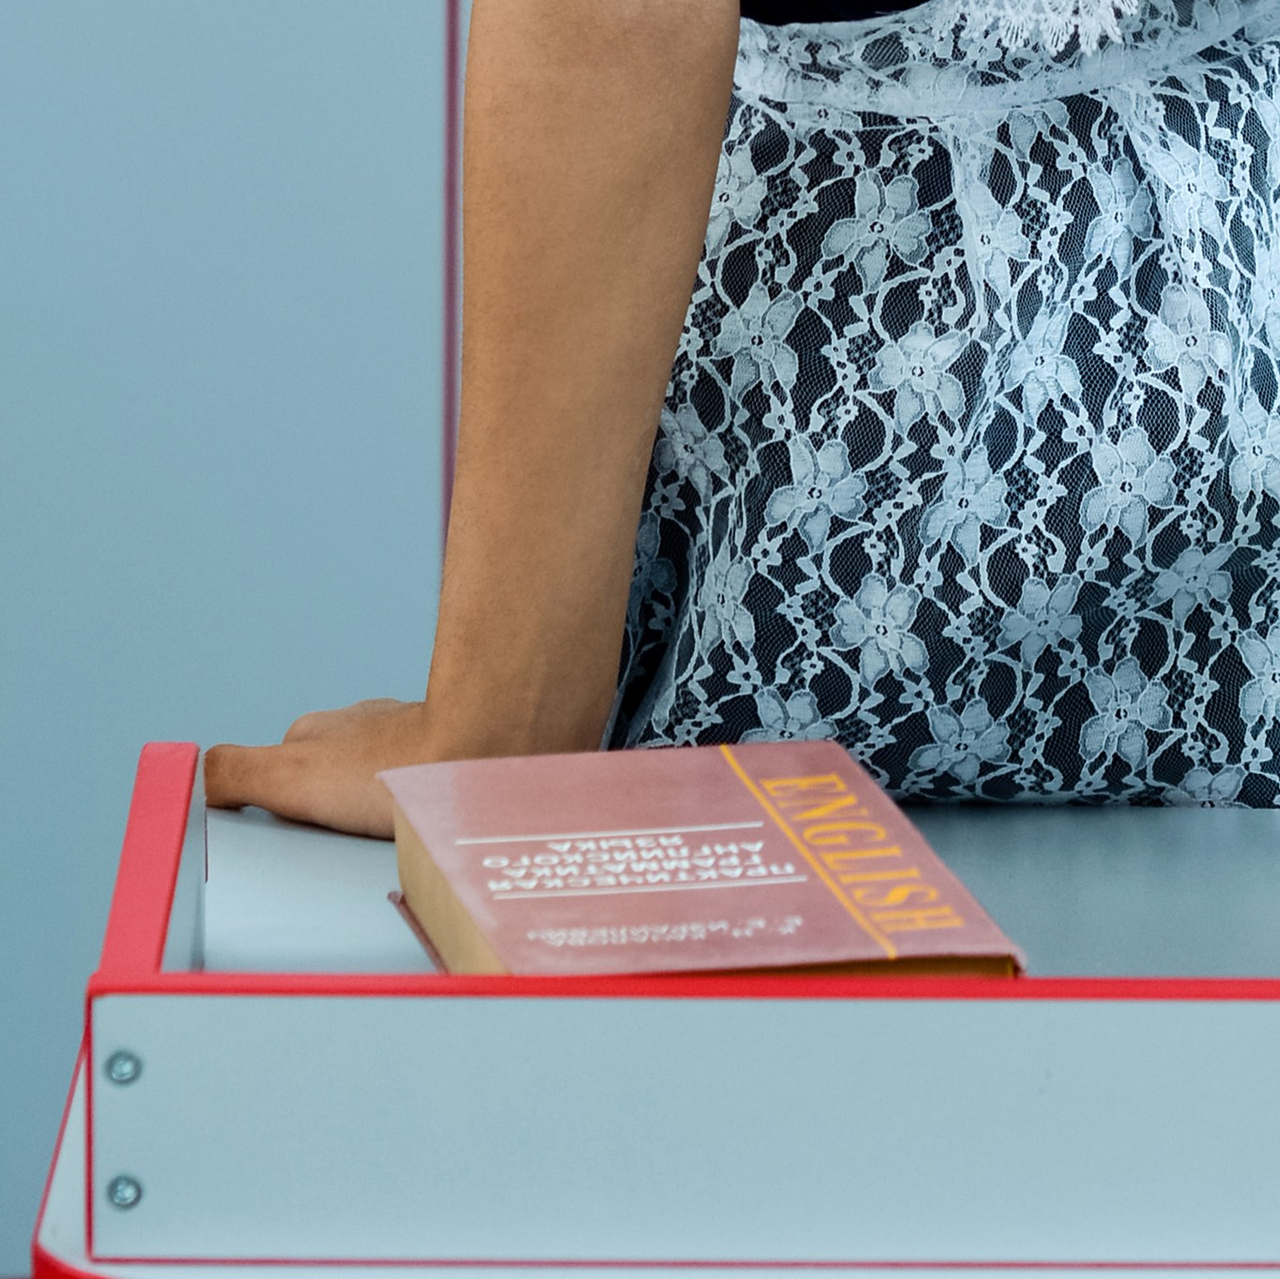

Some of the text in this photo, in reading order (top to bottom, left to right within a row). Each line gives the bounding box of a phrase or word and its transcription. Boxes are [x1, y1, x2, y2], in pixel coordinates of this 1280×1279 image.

[501, 853, 763, 879] ГРАММАТИКА
[761, 772, 964, 935] ENGLISH
[486, 861, 796, 892] ПРАКТИЧЕСКАЯ
